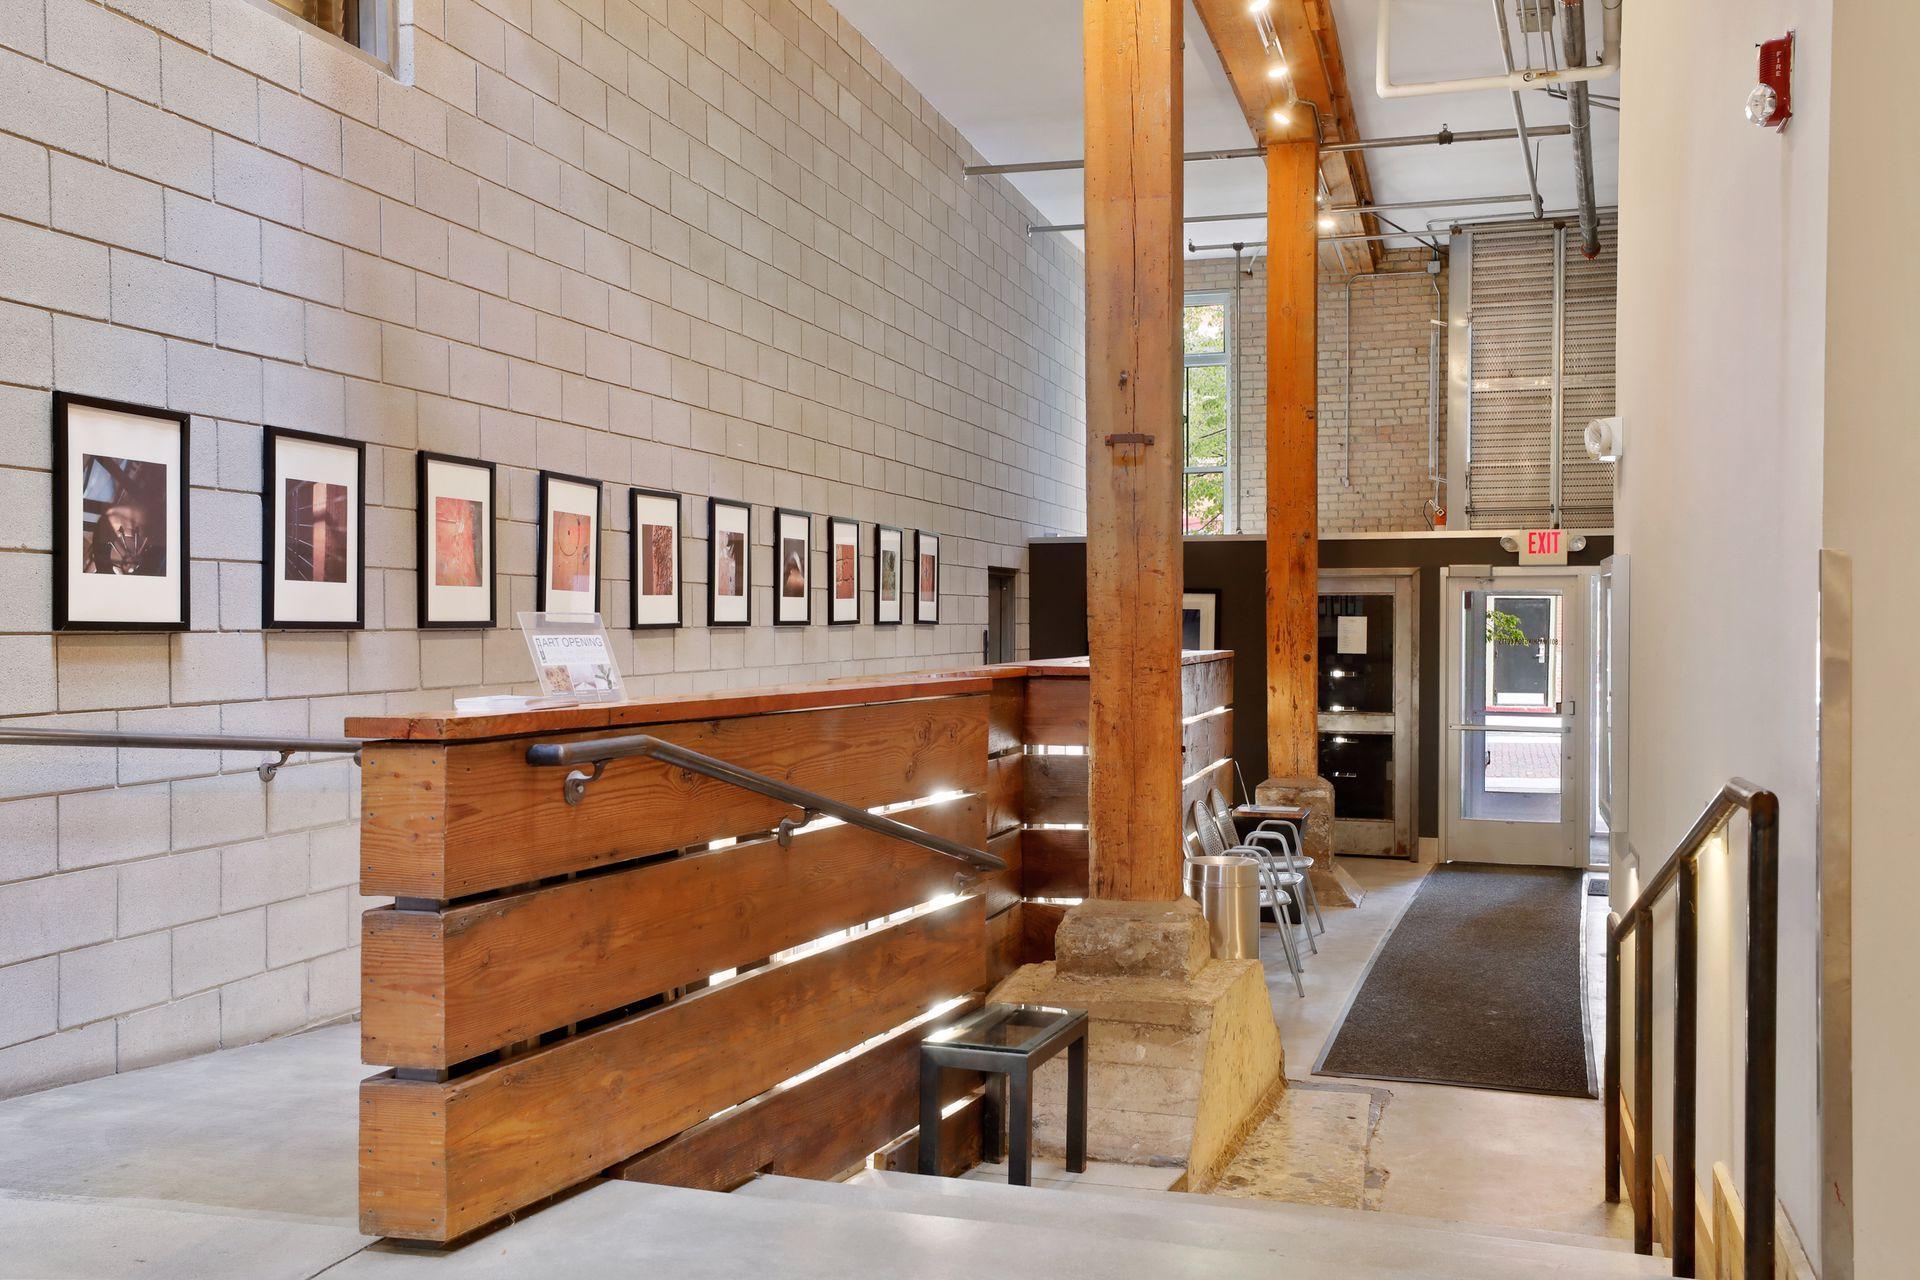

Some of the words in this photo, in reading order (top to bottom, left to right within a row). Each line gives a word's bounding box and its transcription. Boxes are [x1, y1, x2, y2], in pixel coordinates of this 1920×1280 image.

[1528, 531, 1561, 554] EXIT
[542, 638, 559, 647] ART
[562, 637, 603, 648] OPENING
